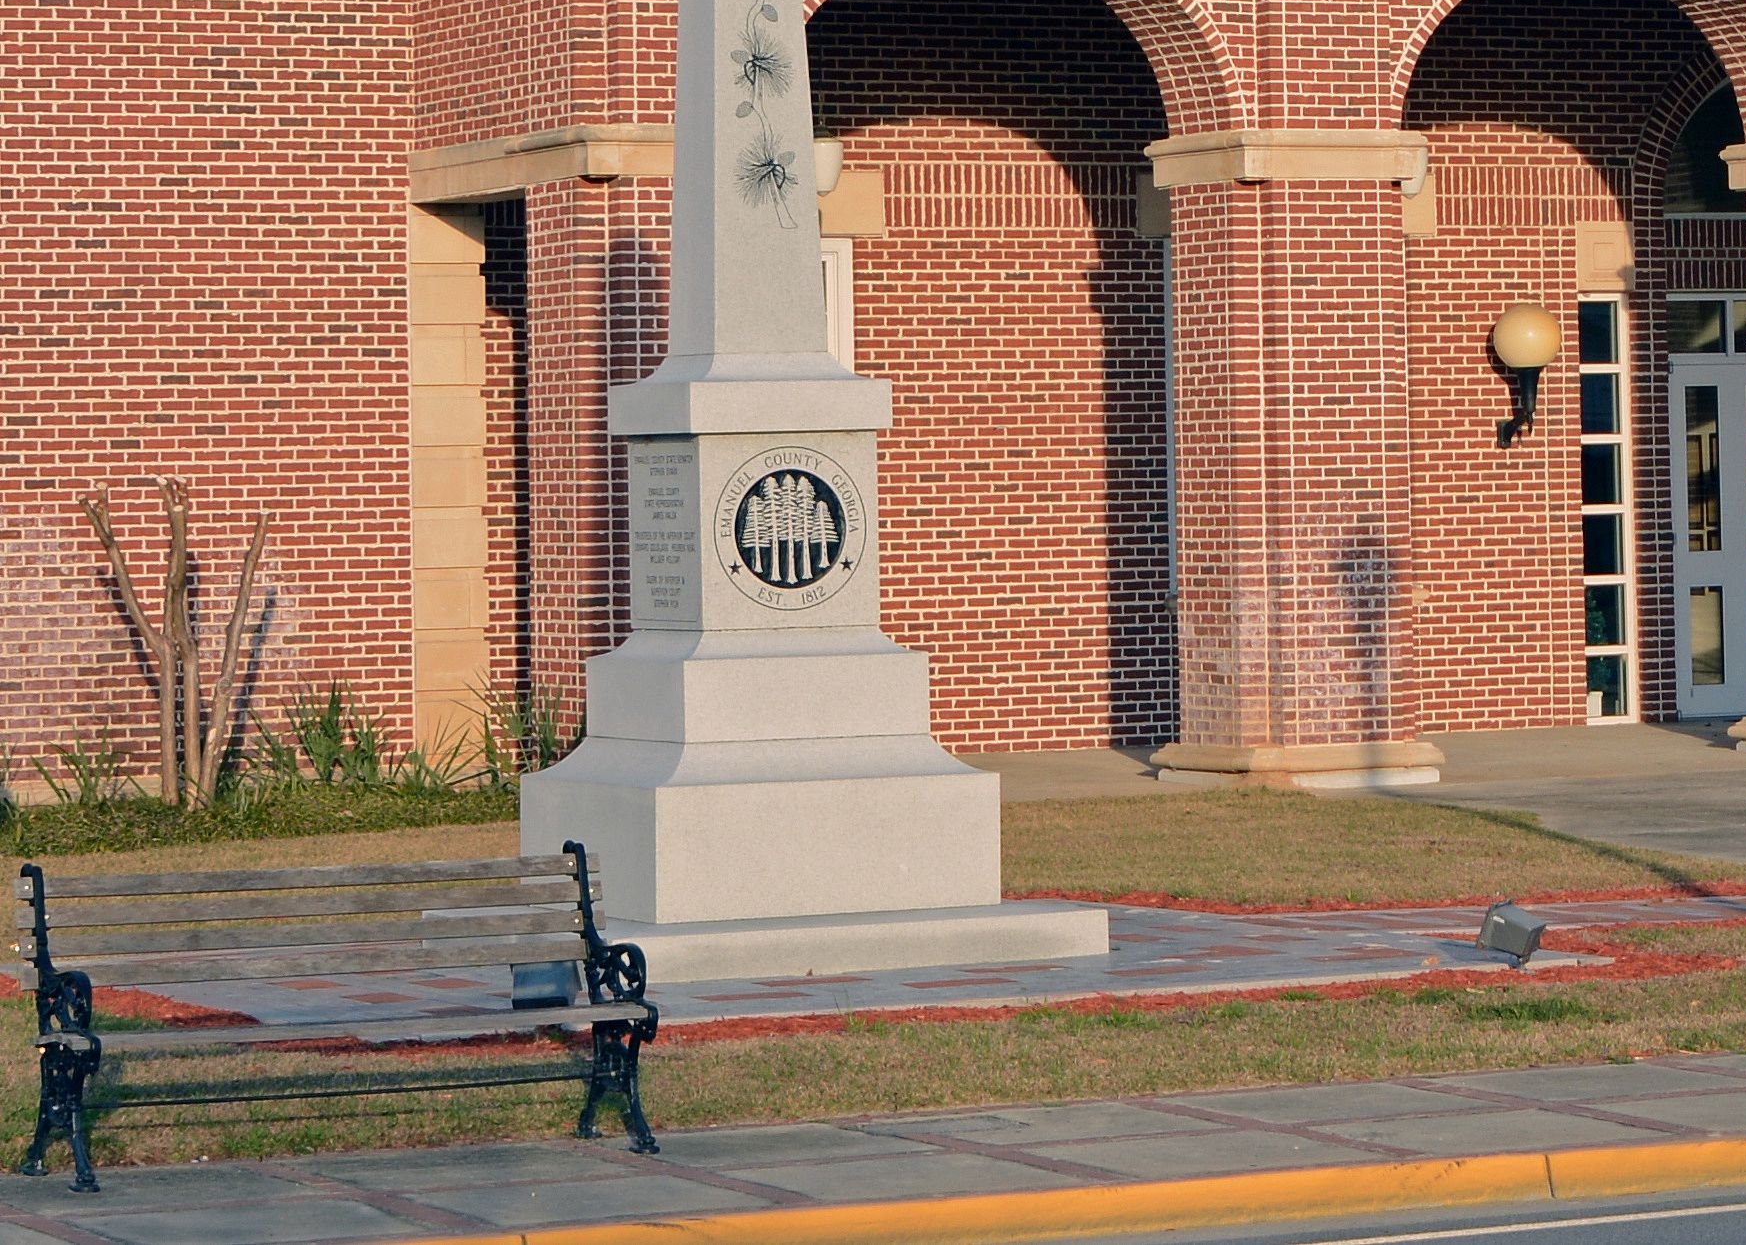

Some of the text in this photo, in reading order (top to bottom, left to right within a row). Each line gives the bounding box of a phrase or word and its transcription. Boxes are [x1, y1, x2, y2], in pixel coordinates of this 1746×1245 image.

[720, 452, 860, 538] EMANUEL COUNTY GEORGIA
[801, 585, 826, 605] 1812
